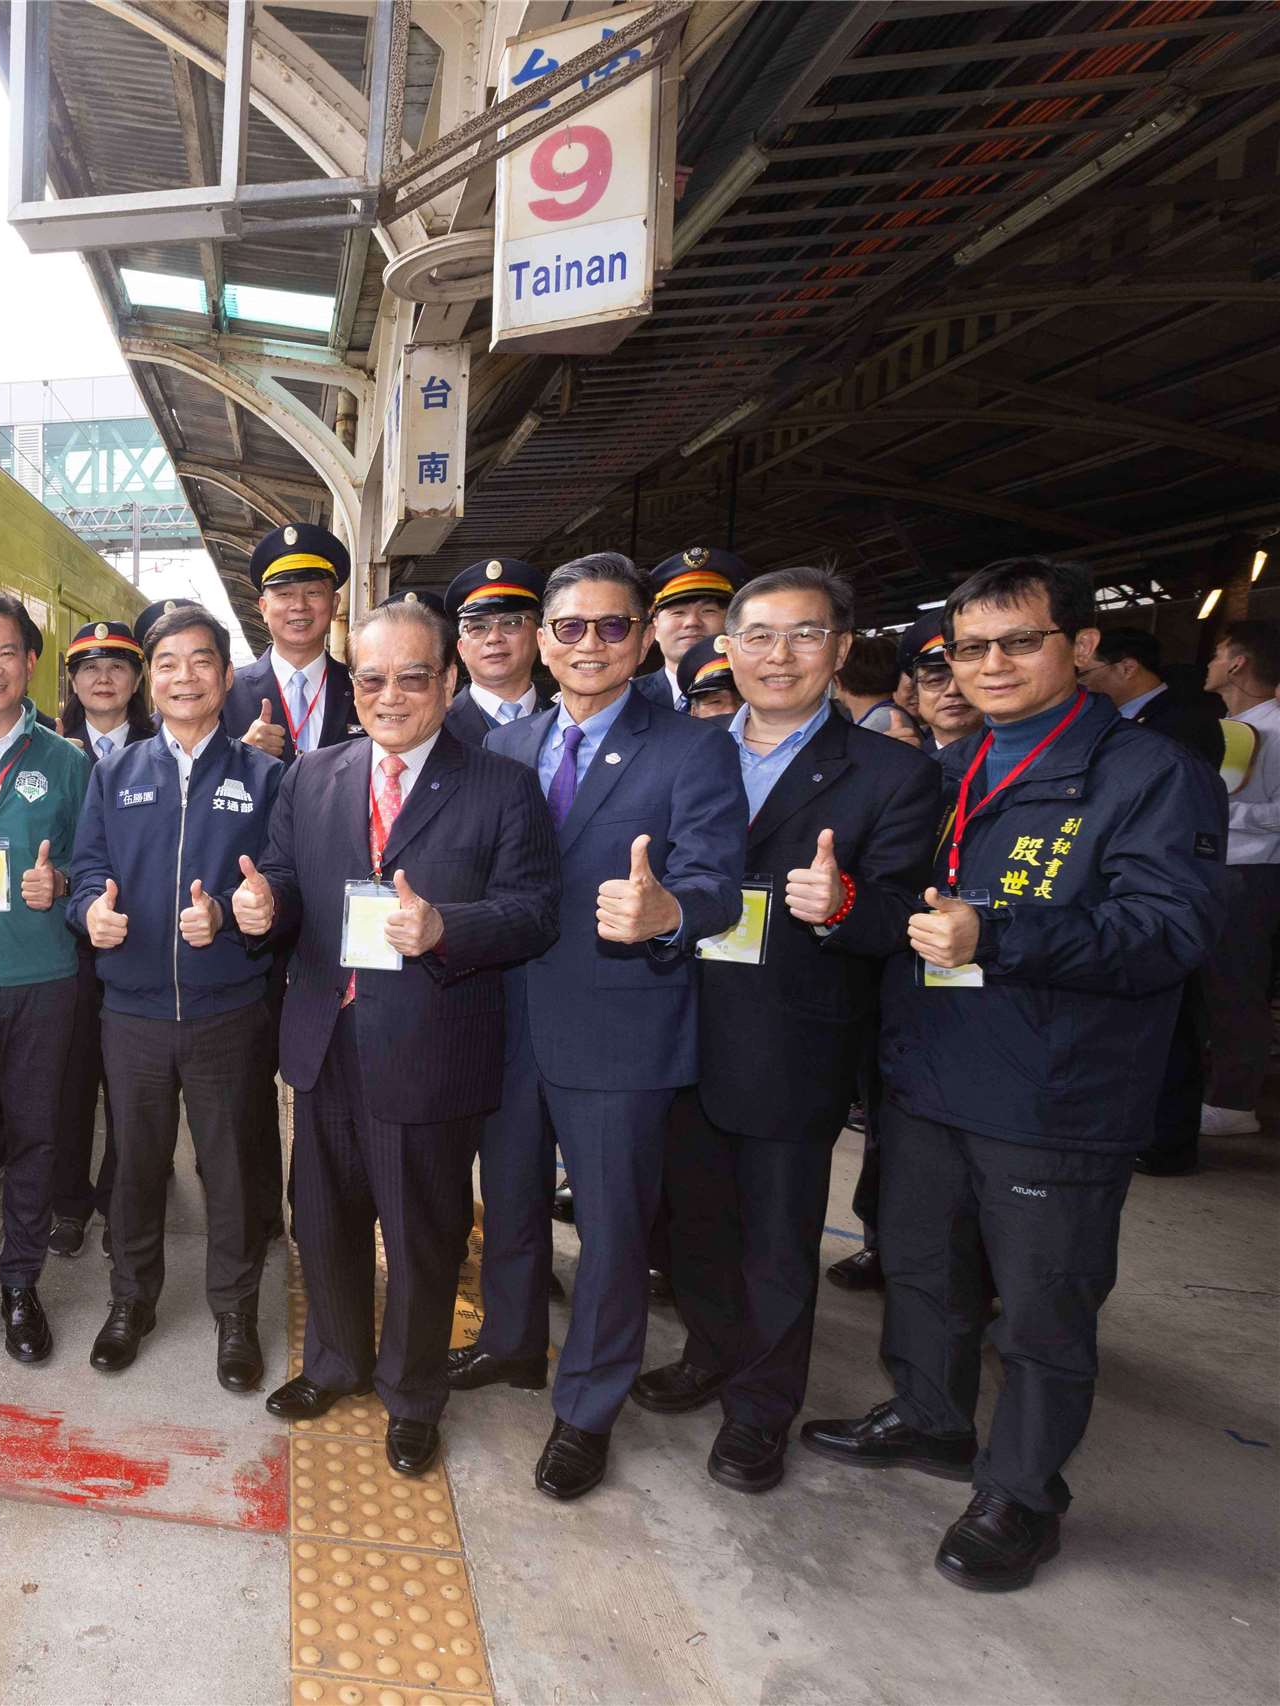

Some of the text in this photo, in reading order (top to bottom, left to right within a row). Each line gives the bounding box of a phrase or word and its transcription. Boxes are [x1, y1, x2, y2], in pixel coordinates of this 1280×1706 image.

[528, 125, 612, 221] 9
[509, 251, 627, 300] Tainan
[417, 375, 452, 485] 台南
[212, 798, 254, 813] 交通部
[993, 835, 1045, 910] 殷世
[1011, 1186, 1047, 1198] ATUNAS
